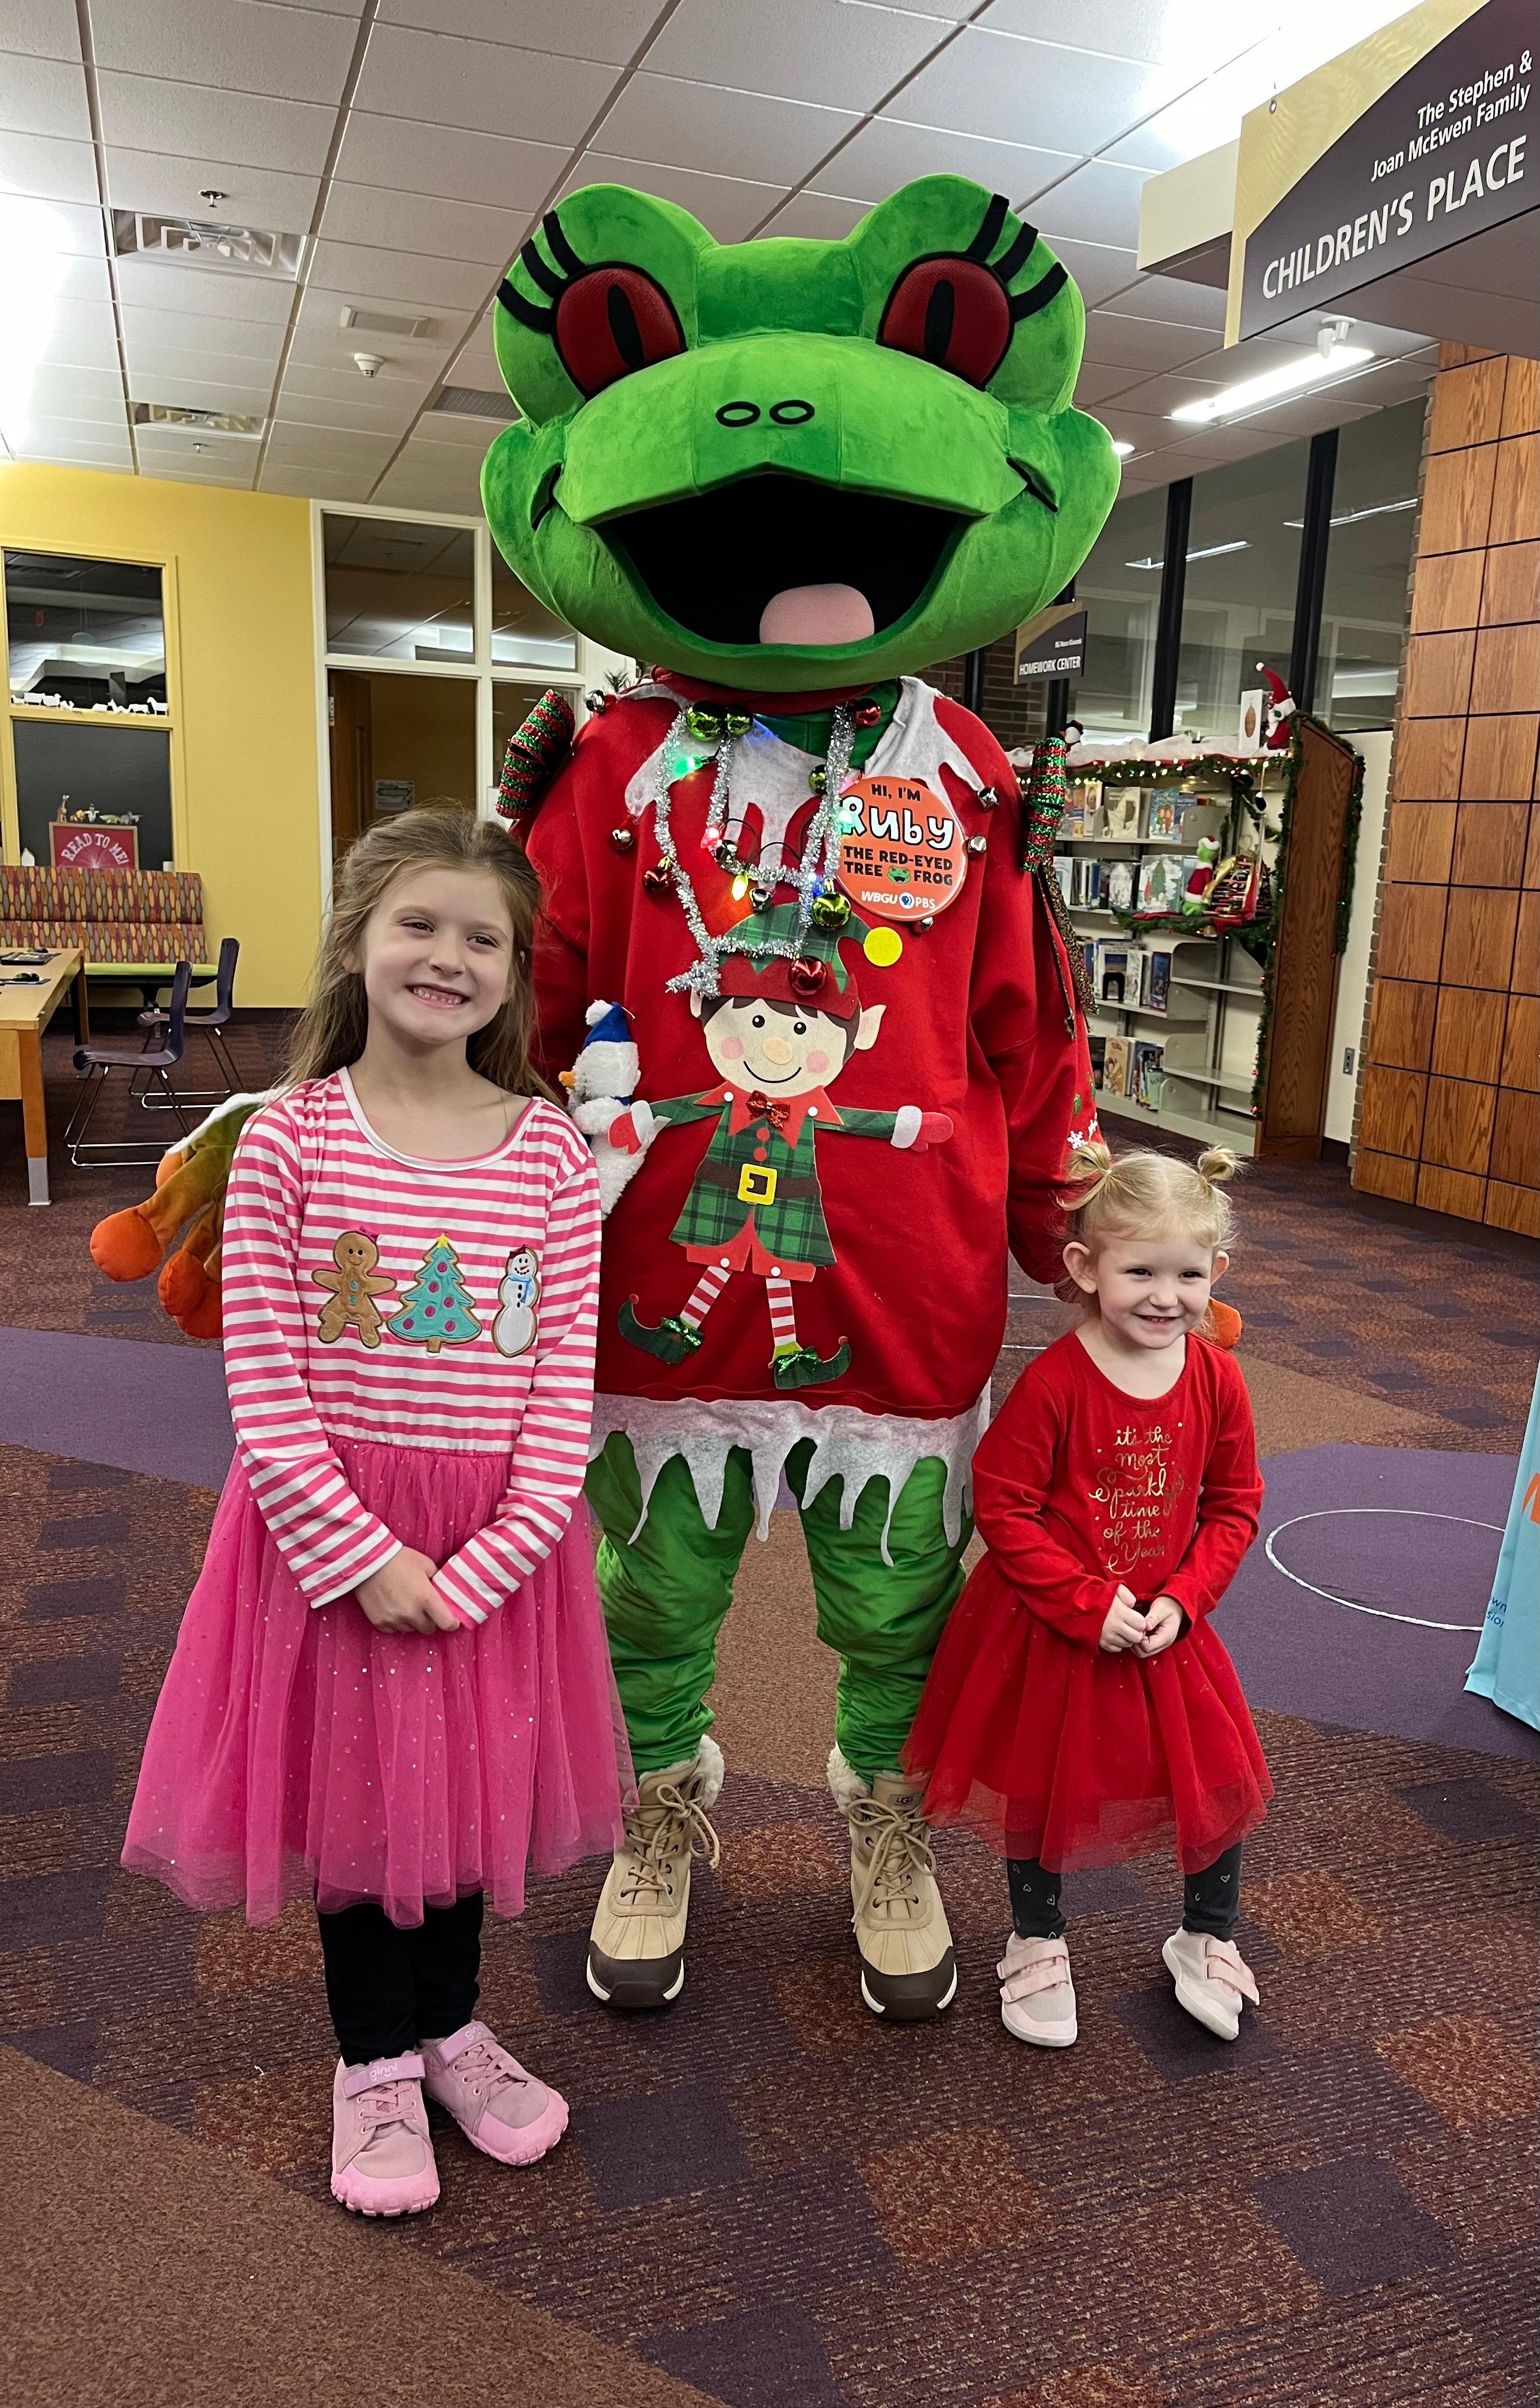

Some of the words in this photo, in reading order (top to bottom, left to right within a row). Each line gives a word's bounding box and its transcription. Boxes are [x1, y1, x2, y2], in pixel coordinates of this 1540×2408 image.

[1417, 103, 1445, 129] The
[1448, 63, 1514, 113] Stephen
[1518, 50, 1533, 72] &
[1371, 152, 1404, 182] Joan
[1407, 115, 1472, 163] McEwen
[1476, 84, 1531, 124] Family
[1262, 191, 1414, 300] CHILDREN'S
[1426, 135, 1527, 222] PLACE
[1019, 659, 1057, 675] HOMEWORK
[1057, 656, 1081, 670] CENTER
[871, 784, 892, 799] HI,
[898, 787, 920, 801] I'M
[838, 795, 955, 851] Ruby
[61, 833, 92, 862] READ
[95, 833, 111, 848] TO
[109, 842, 130, 864] ME!
[843, 845, 873, 860] THE
[879, 850, 953, 870] RED-EYED
[844, 861, 883, 877] TREE
[914, 870, 953, 886] FROG
[861, 891, 898, 904] WBGU
[916, 898, 936, 909] PBS
[1114, 1426, 1141, 1446] it's
[1145, 1426, 1173, 1444] the
[1115, 1444, 1169, 1471] most
[1120, 1500, 1160, 1519] time
[1103, 1520, 1127, 1546] of
[1132, 1520, 1160, 1539] the
[896, 1796, 914, 1805] UGG
